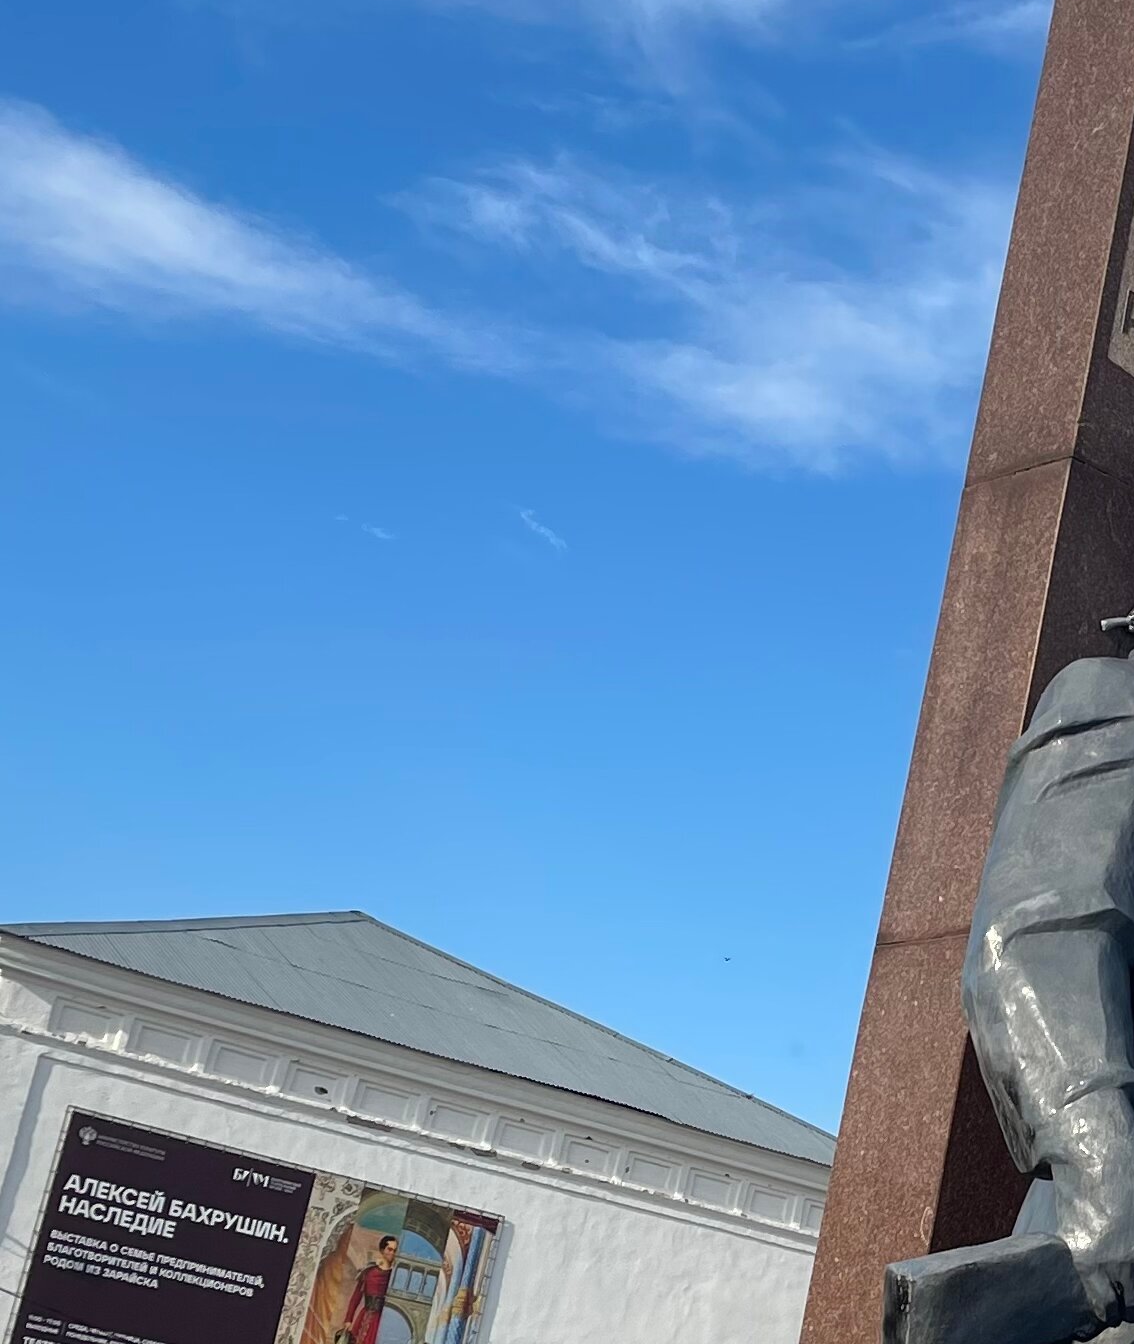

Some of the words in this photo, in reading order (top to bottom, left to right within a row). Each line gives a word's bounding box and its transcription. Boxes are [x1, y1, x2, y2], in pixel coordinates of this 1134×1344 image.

[58, 1195, 176, 1238] НАСЛЕДИЕ
[63, 1174, 165, 1212] АЛЕКСЕЙ
[168, 1199, 288, 1243] БАХРУШИН.
[49, 1229, 107, 1250] ВЫСТАВКА
[108, 1242, 119, 1253] О
[119, 1246, 155, 1261] СЕМЬЕ
[43, 1254, 84, 1270] РОДОМ
[85, 1264, 101, 1275] ИЗ
[102, 1267, 158, 1288] ЗАРАЙСКА
[46, 1241, 148, 1272] БЛАГОТВОРИТЕЛЕЙ
[148, 1263, 159, 1276] И
[158, 1268, 253, 1296] КОЛЛЕКЦИОНЕРОВ
